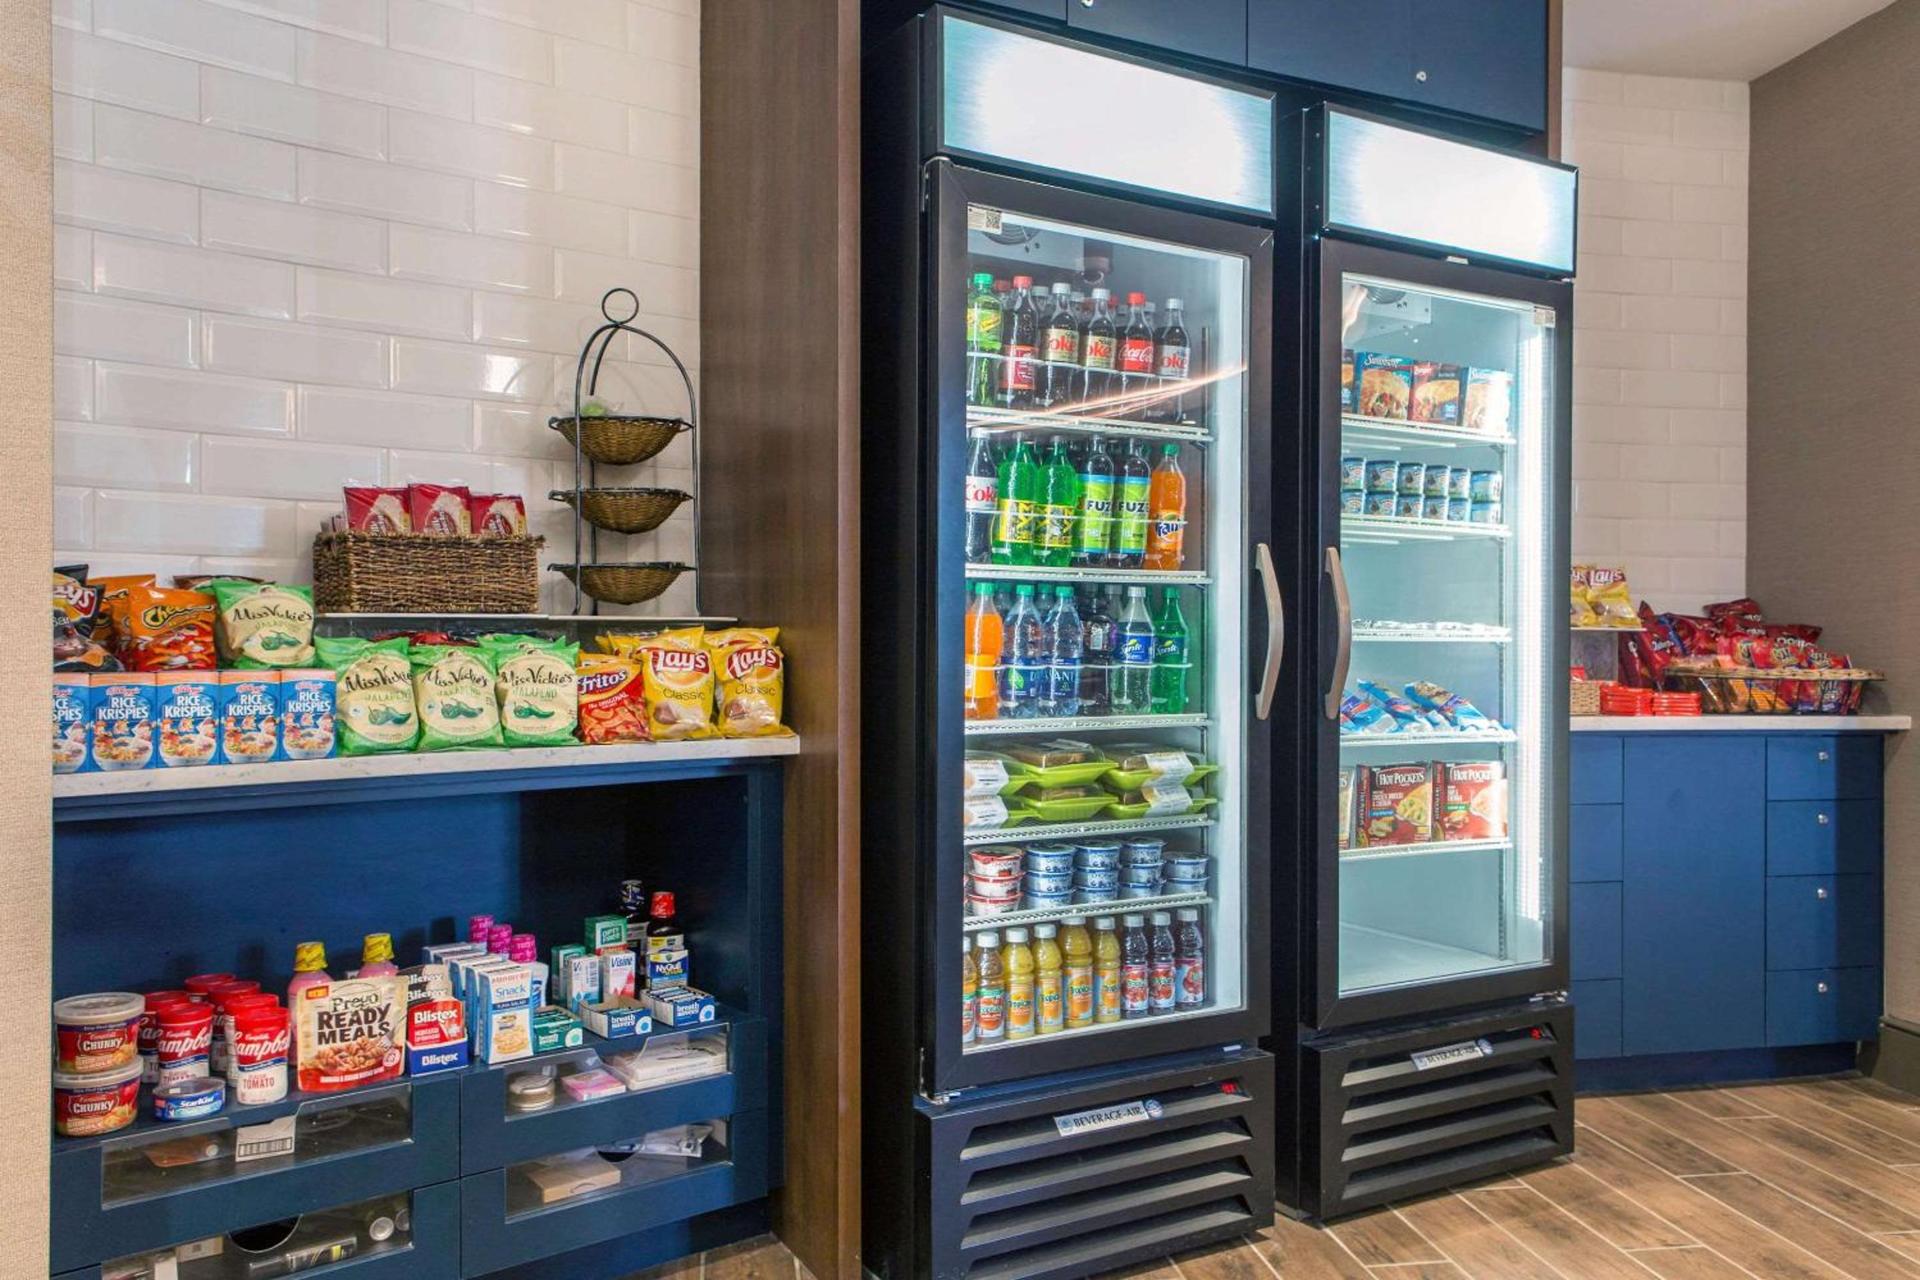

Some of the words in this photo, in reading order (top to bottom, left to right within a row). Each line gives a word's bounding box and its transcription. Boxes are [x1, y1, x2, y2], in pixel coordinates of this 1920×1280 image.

[1087, 500, 1112, 512] FUZ
[111, 697, 137, 708] RICE
[176, 695, 201, 707] RICE
[240, 694, 262, 705] RICE
[299, 691, 321, 702] RICE
[55, 699, 69, 709] CE
[229, 703, 274, 716] KRISPIES
[288, 700, 331, 712] KRISPIES
[98, 706, 149, 719] KRISPIES
[165, 704, 213, 718] KRISPIES
[495, 984, 526, 999] Snack
[318, 1003, 392, 1031] READY
[414, 1009, 458, 1025] Blistex
[318, 1021, 391, 1046] MEALS
[82, 1038, 123, 1052] CHUNKY
[421, 1052, 459, 1067] Blistex
[243, 1077, 275, 1091] TOMATO
[72, 1099, 115, 1114] CHUNKY
